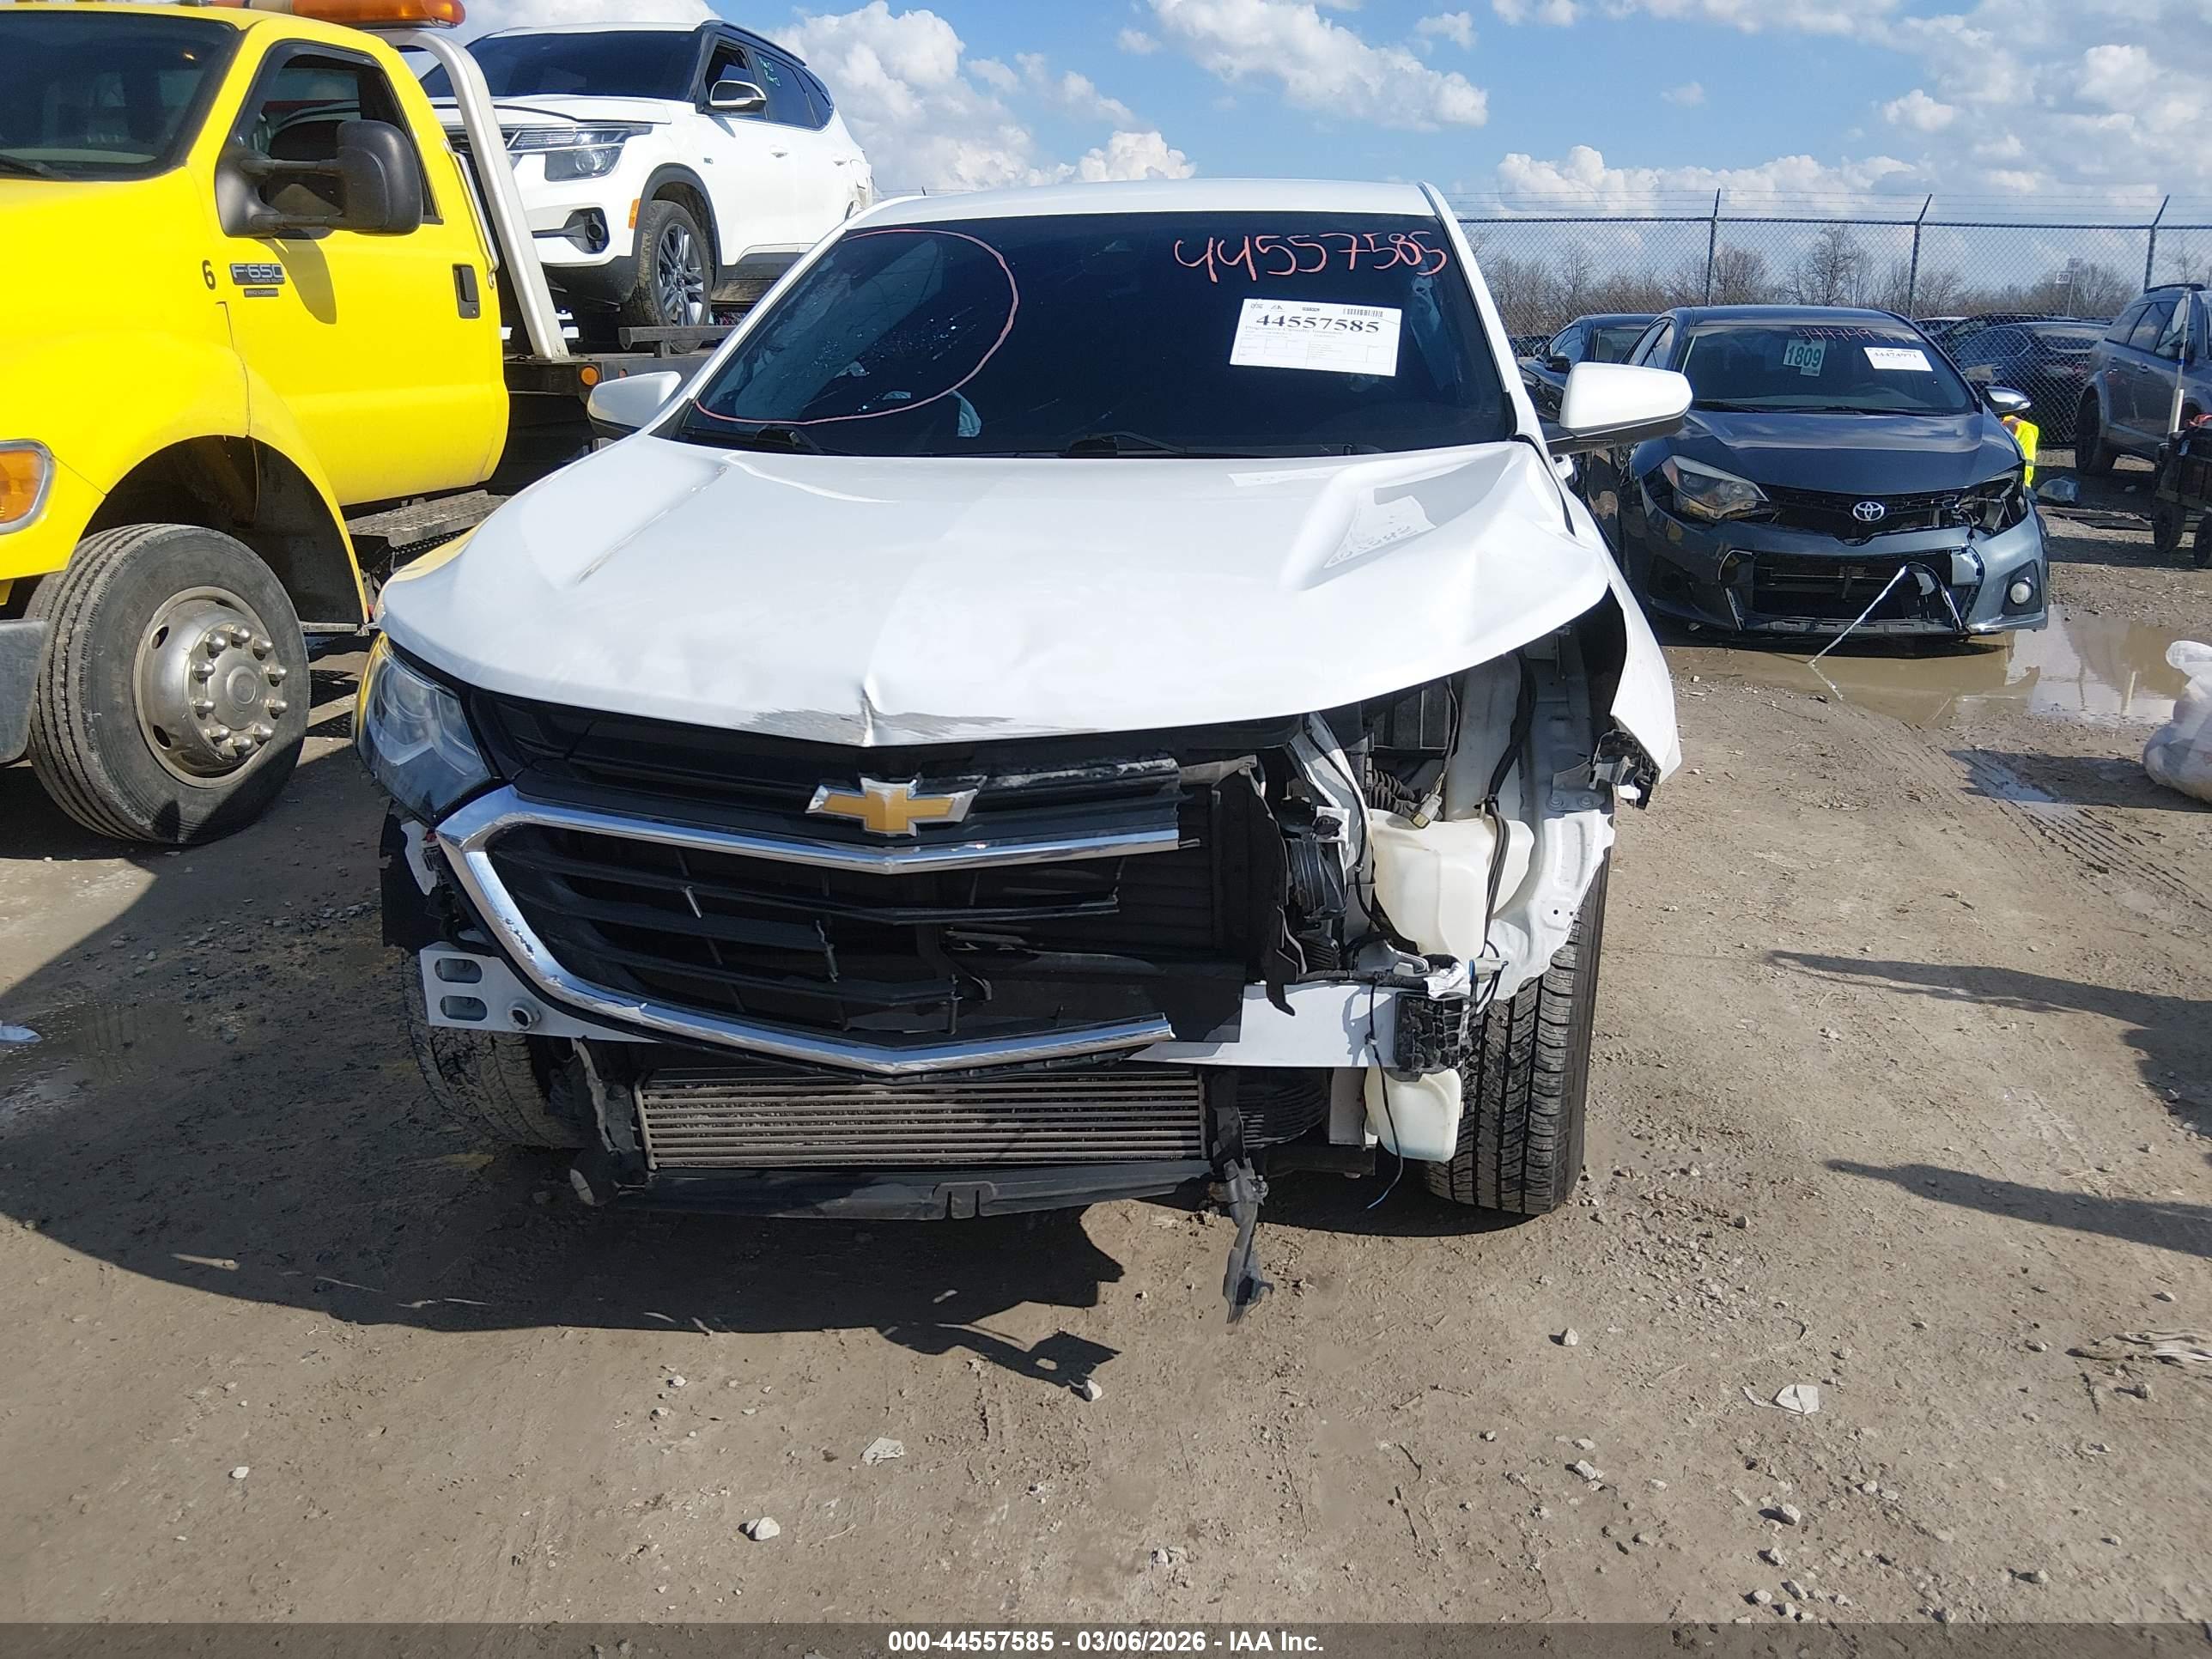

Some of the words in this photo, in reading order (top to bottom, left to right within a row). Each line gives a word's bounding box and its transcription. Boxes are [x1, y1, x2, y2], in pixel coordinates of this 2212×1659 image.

[1174, 231, 1448, 283] 44557585
[202, 259, 216, 289] 6
[1255, 313, 1381, 334] 44557585
[1787, 345, 1821, 368] 1809
